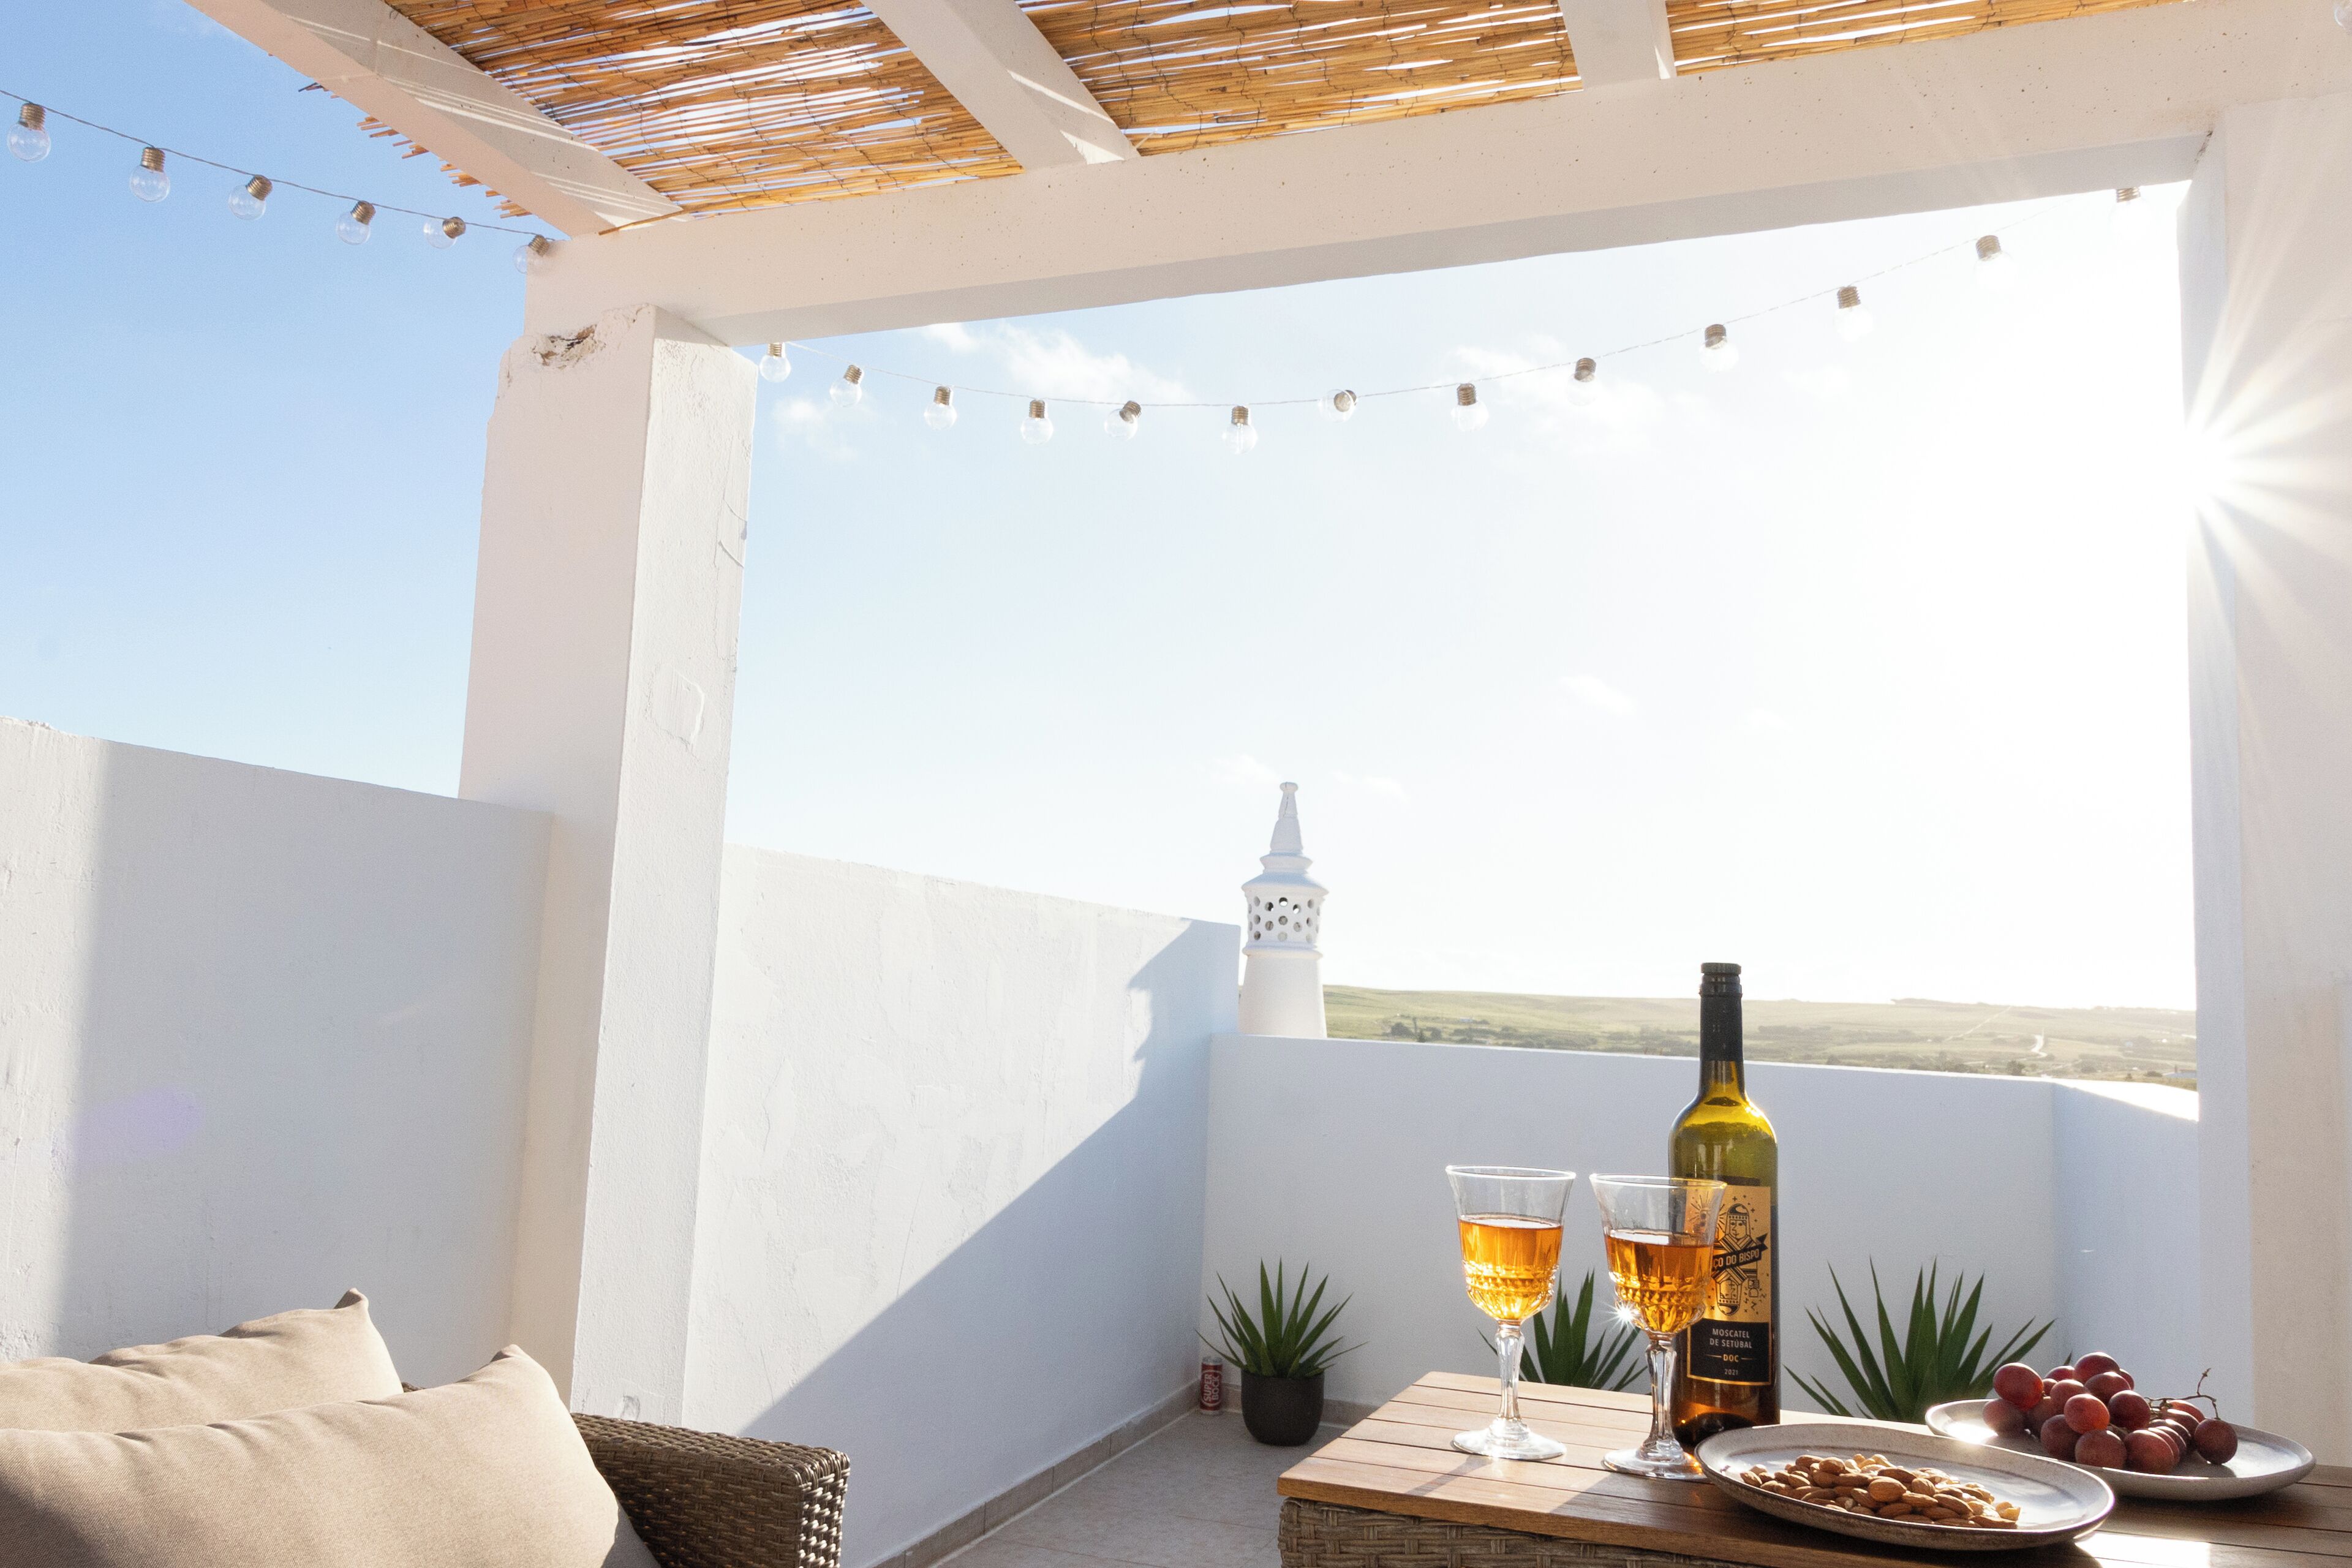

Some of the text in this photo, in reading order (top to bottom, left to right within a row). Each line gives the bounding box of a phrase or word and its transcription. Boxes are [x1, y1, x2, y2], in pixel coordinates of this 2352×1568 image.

[1726, 1255, 1736, 1265] DO
[1740, 1248, 1759, 1262] BISPO
[1712, 1328, 1750, 1338] MOSCATEL
[1709, 1338, 1752, 1349] DE SETÚBAL
[1723, 1354, 1739, 1363] DOC
[1204, 1374, 1212, 1401] SUPER
